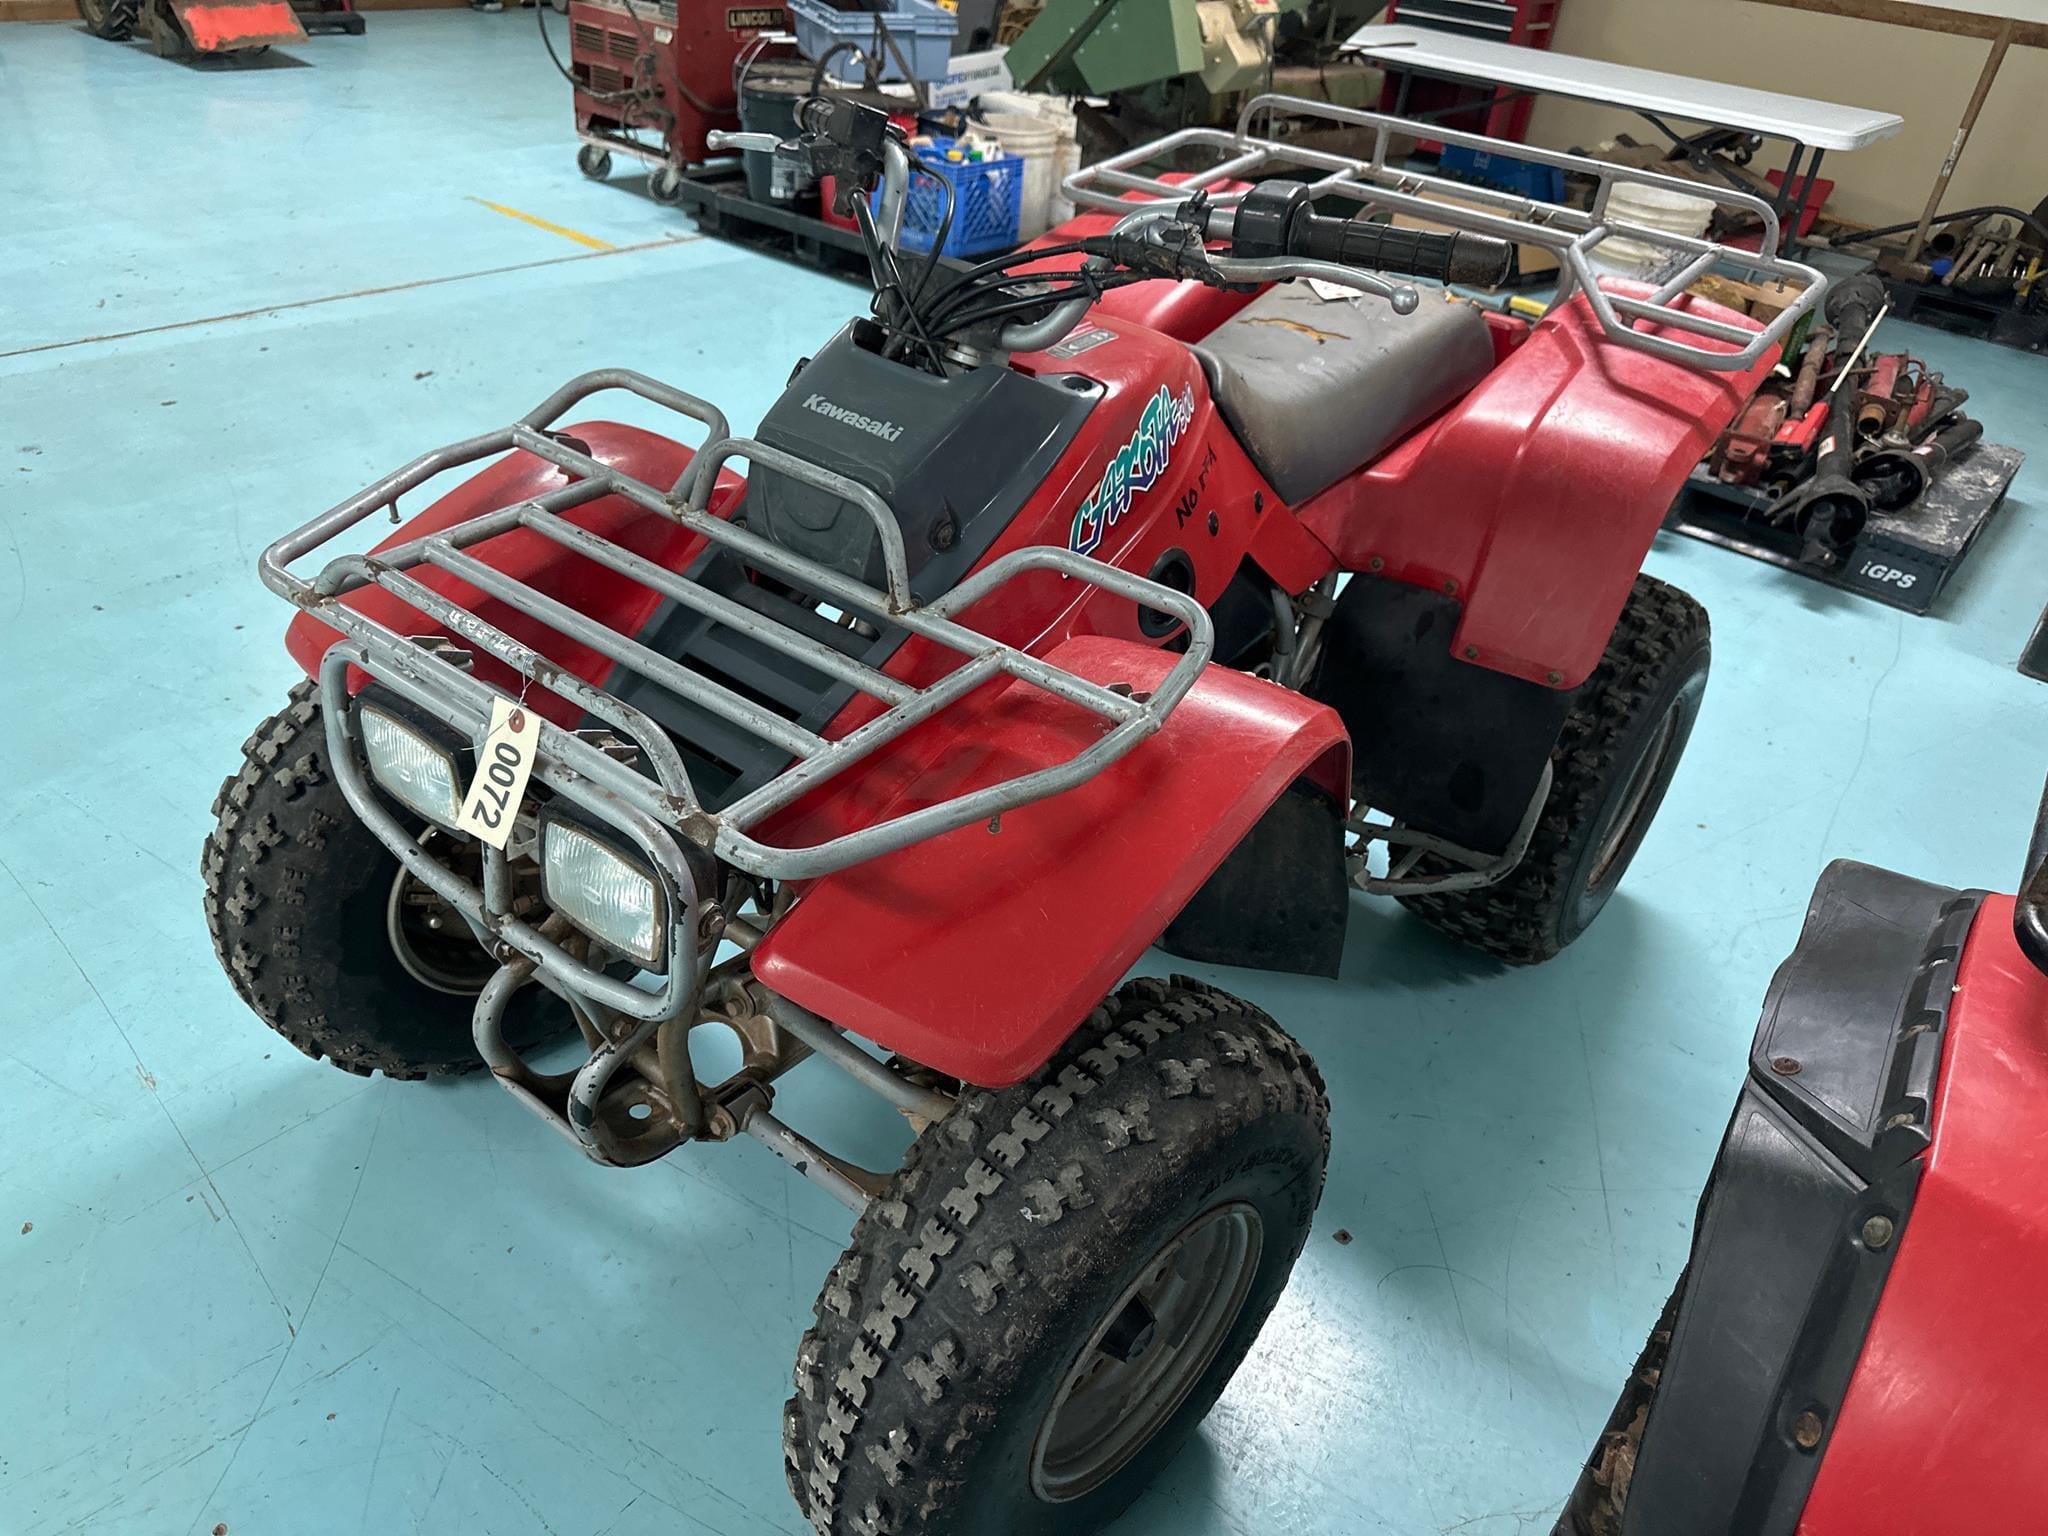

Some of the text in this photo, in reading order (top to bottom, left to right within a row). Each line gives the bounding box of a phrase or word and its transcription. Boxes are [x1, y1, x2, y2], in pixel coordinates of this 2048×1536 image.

[802, 393, 904, 442] Kawasaki
[1860, 561, 1917, 588] iGPS
[472, 742, 522, 829] 0072
